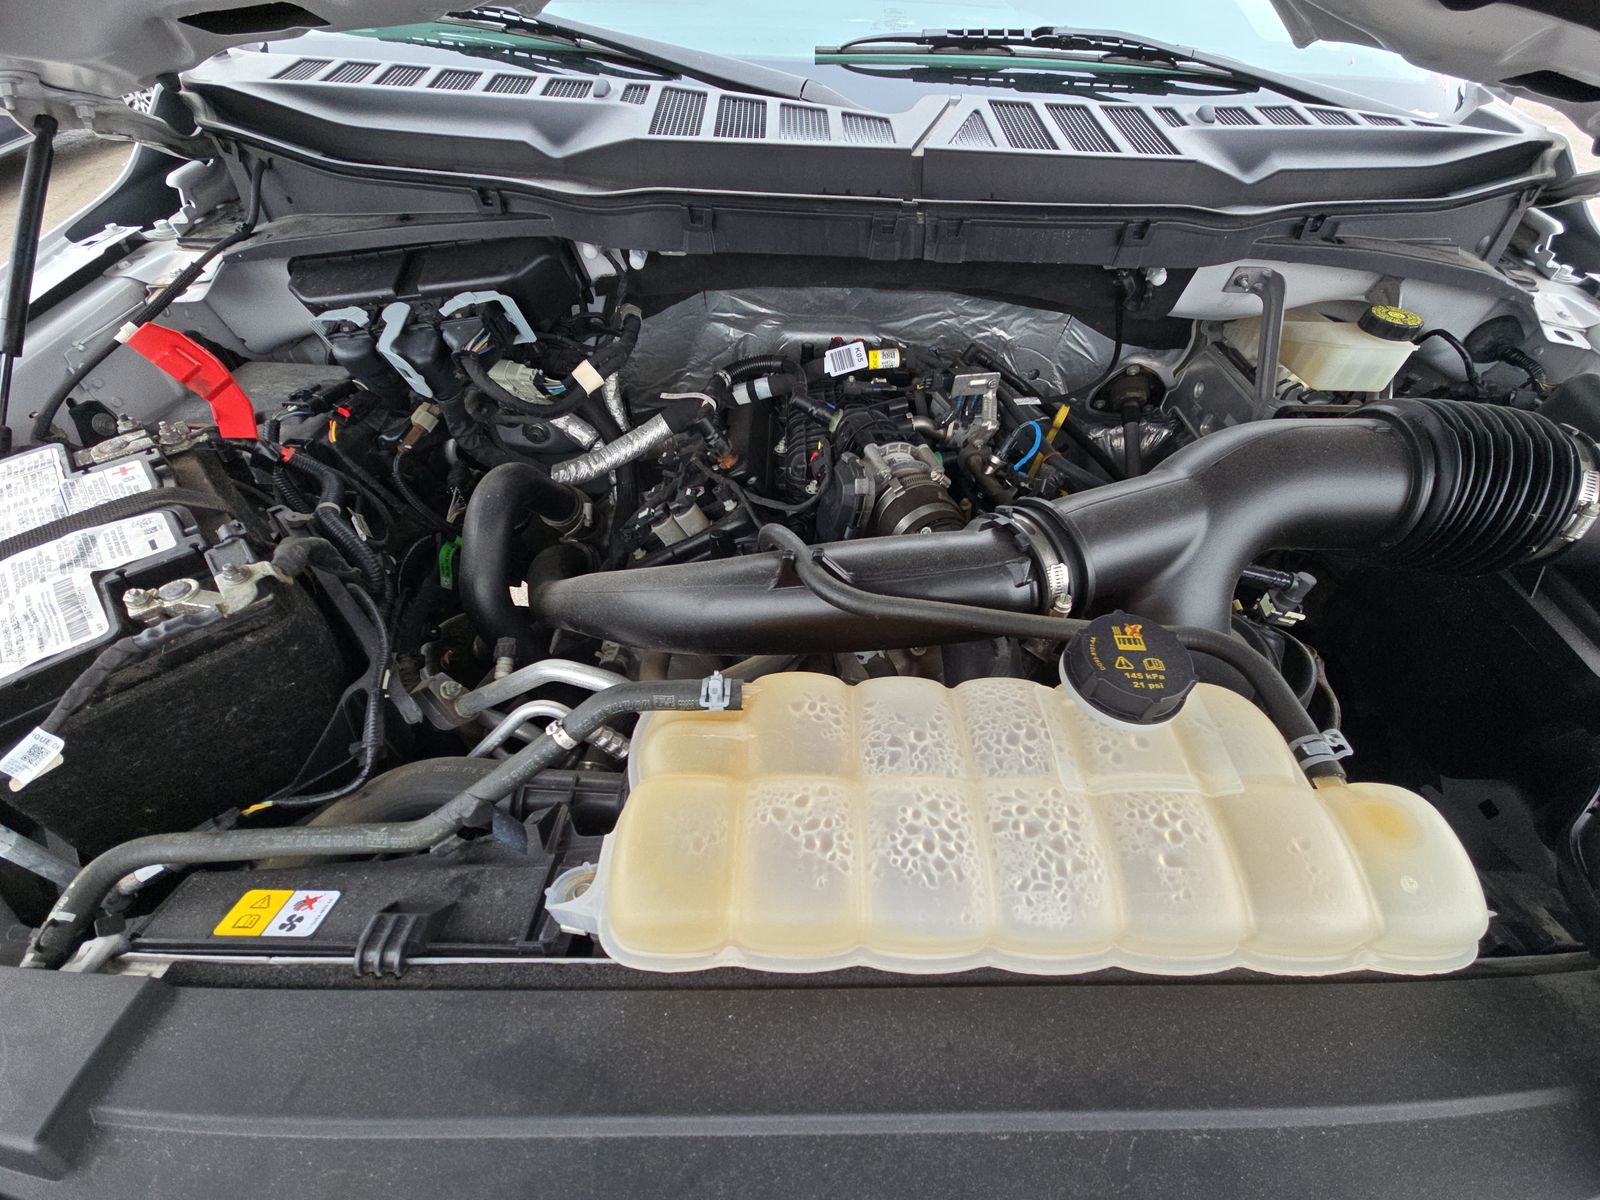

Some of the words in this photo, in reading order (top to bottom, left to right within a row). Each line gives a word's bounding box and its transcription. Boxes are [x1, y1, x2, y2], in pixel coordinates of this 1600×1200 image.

[855, 346, 864, 363] K05
[1124, 672, 1144, 680] 145
[1145, 672, 1166, 680] kPa
[1132, 681, 1145, 689] 21
[1148, 682, 1164, 690] psi
